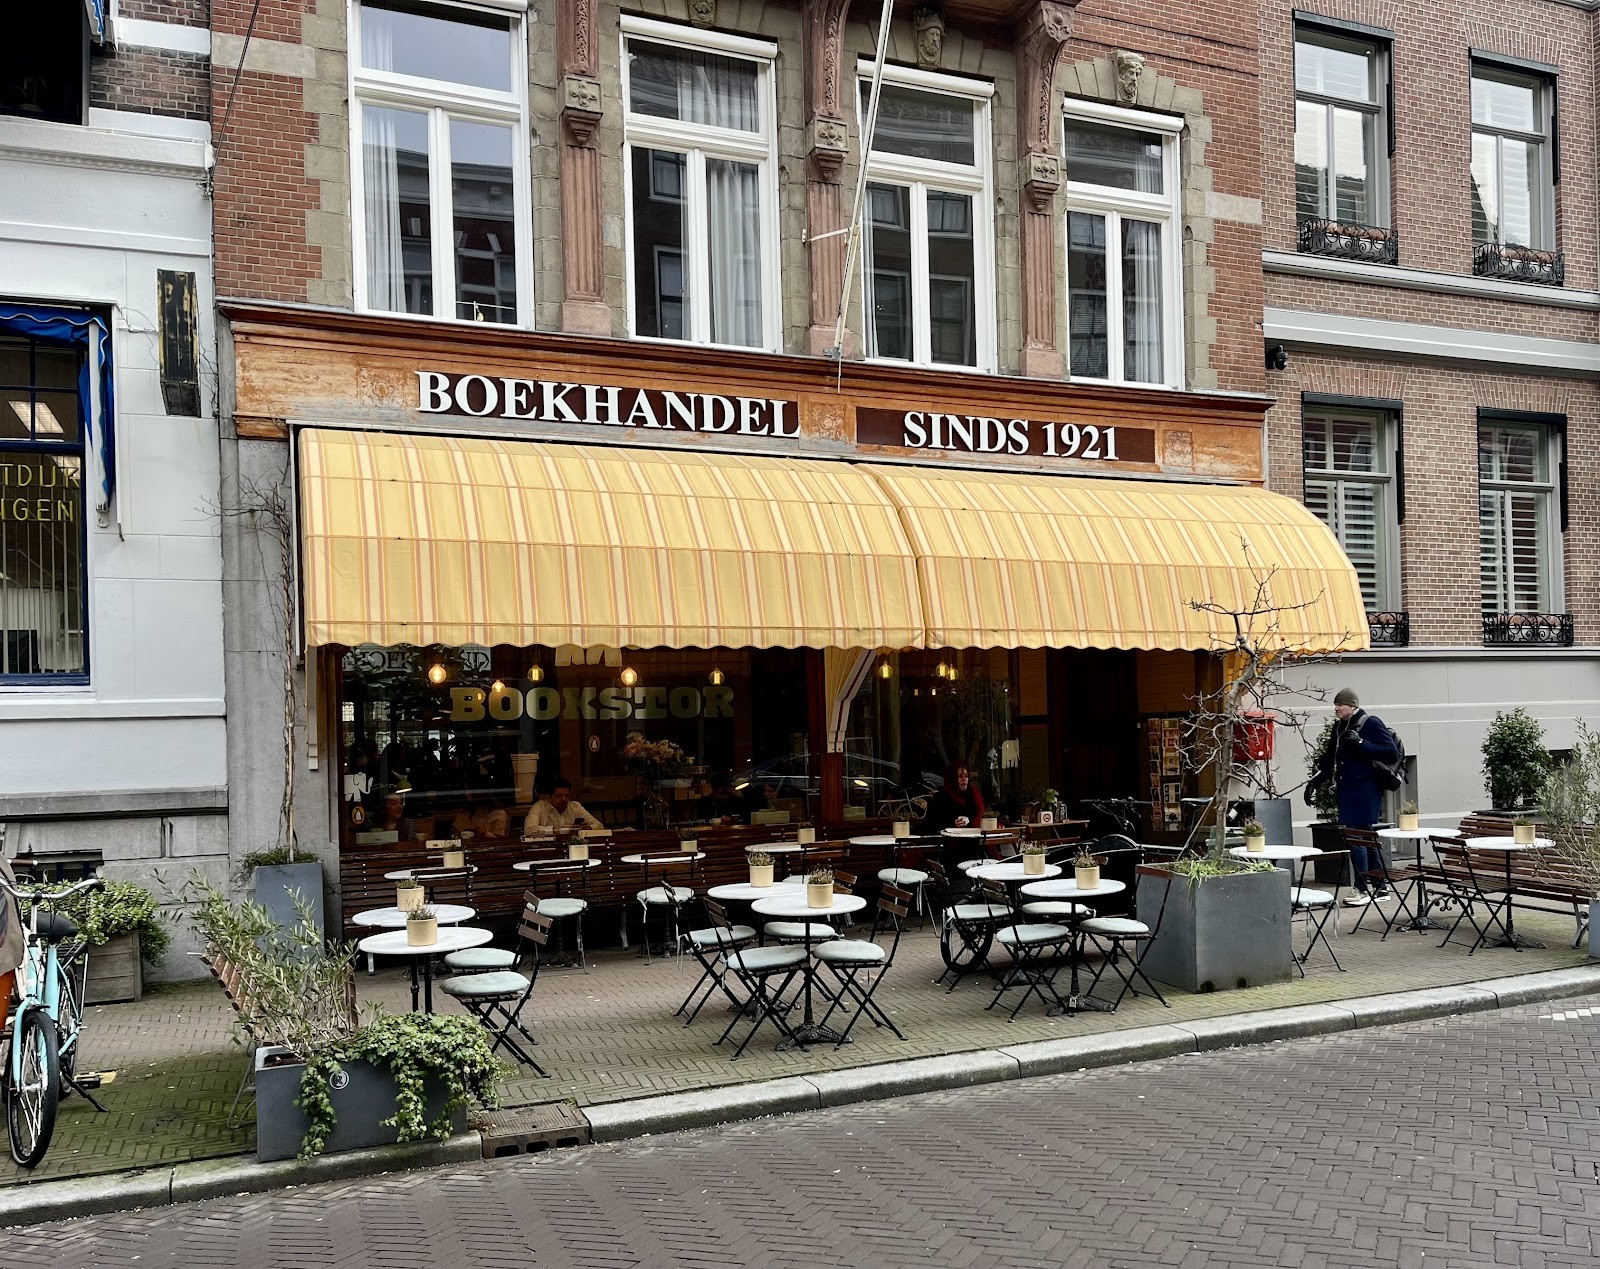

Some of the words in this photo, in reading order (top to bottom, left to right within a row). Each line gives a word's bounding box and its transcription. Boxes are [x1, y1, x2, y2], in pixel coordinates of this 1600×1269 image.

[414, 371, 800, 438] BOEKHANDEL
[903, 411, 1029, 455] SINDS
[1042, 422, 1120, 461] 1921
[449, 686, 734, 723] BOOKSTOR
